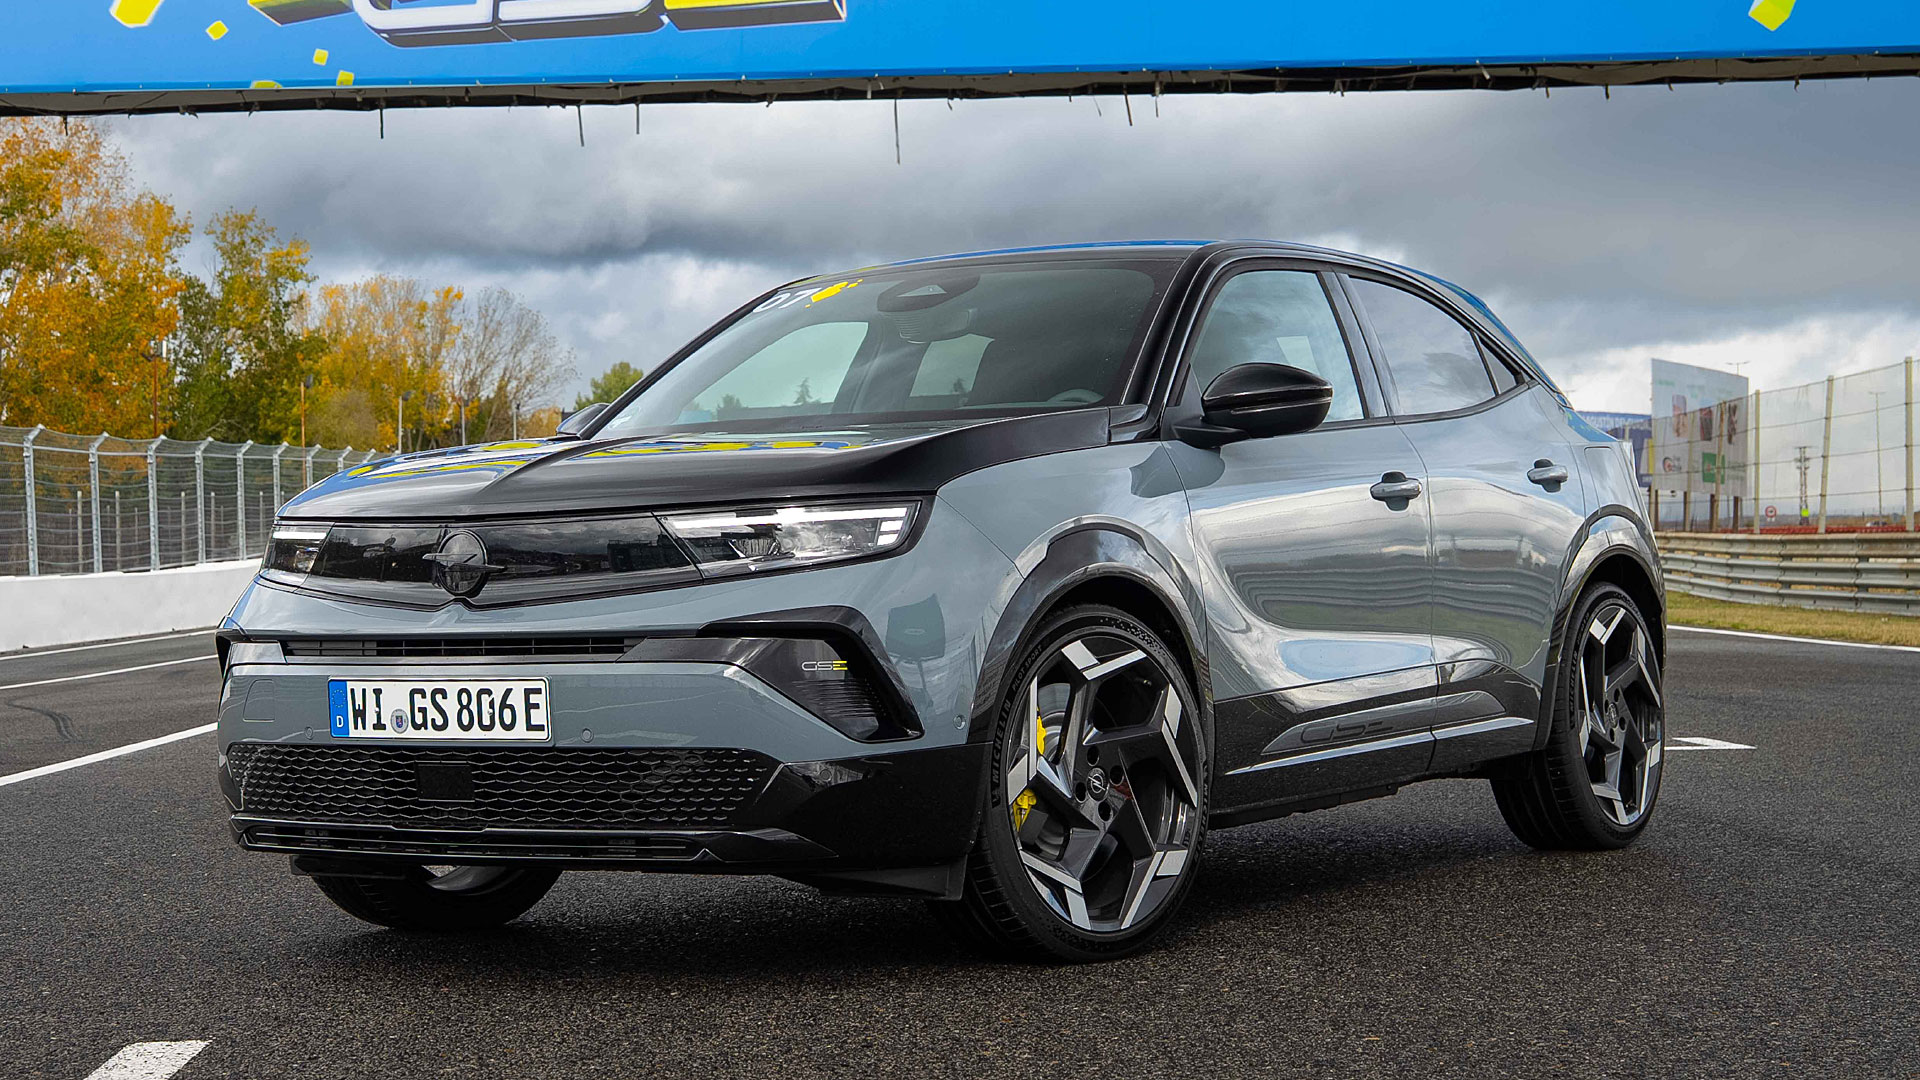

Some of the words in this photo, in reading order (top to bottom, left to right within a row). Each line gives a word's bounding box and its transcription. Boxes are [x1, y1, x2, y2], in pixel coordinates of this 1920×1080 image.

[801, 660, 849, 671] GSE
[336, 715, 344, 728] D
[350, 688, 387, 731] WI
[991, 699, 1012, 784] MICHELIN
[1011, 669, 1026, 691] PILOT
[1025, 646, 1043, 668] SPORT
